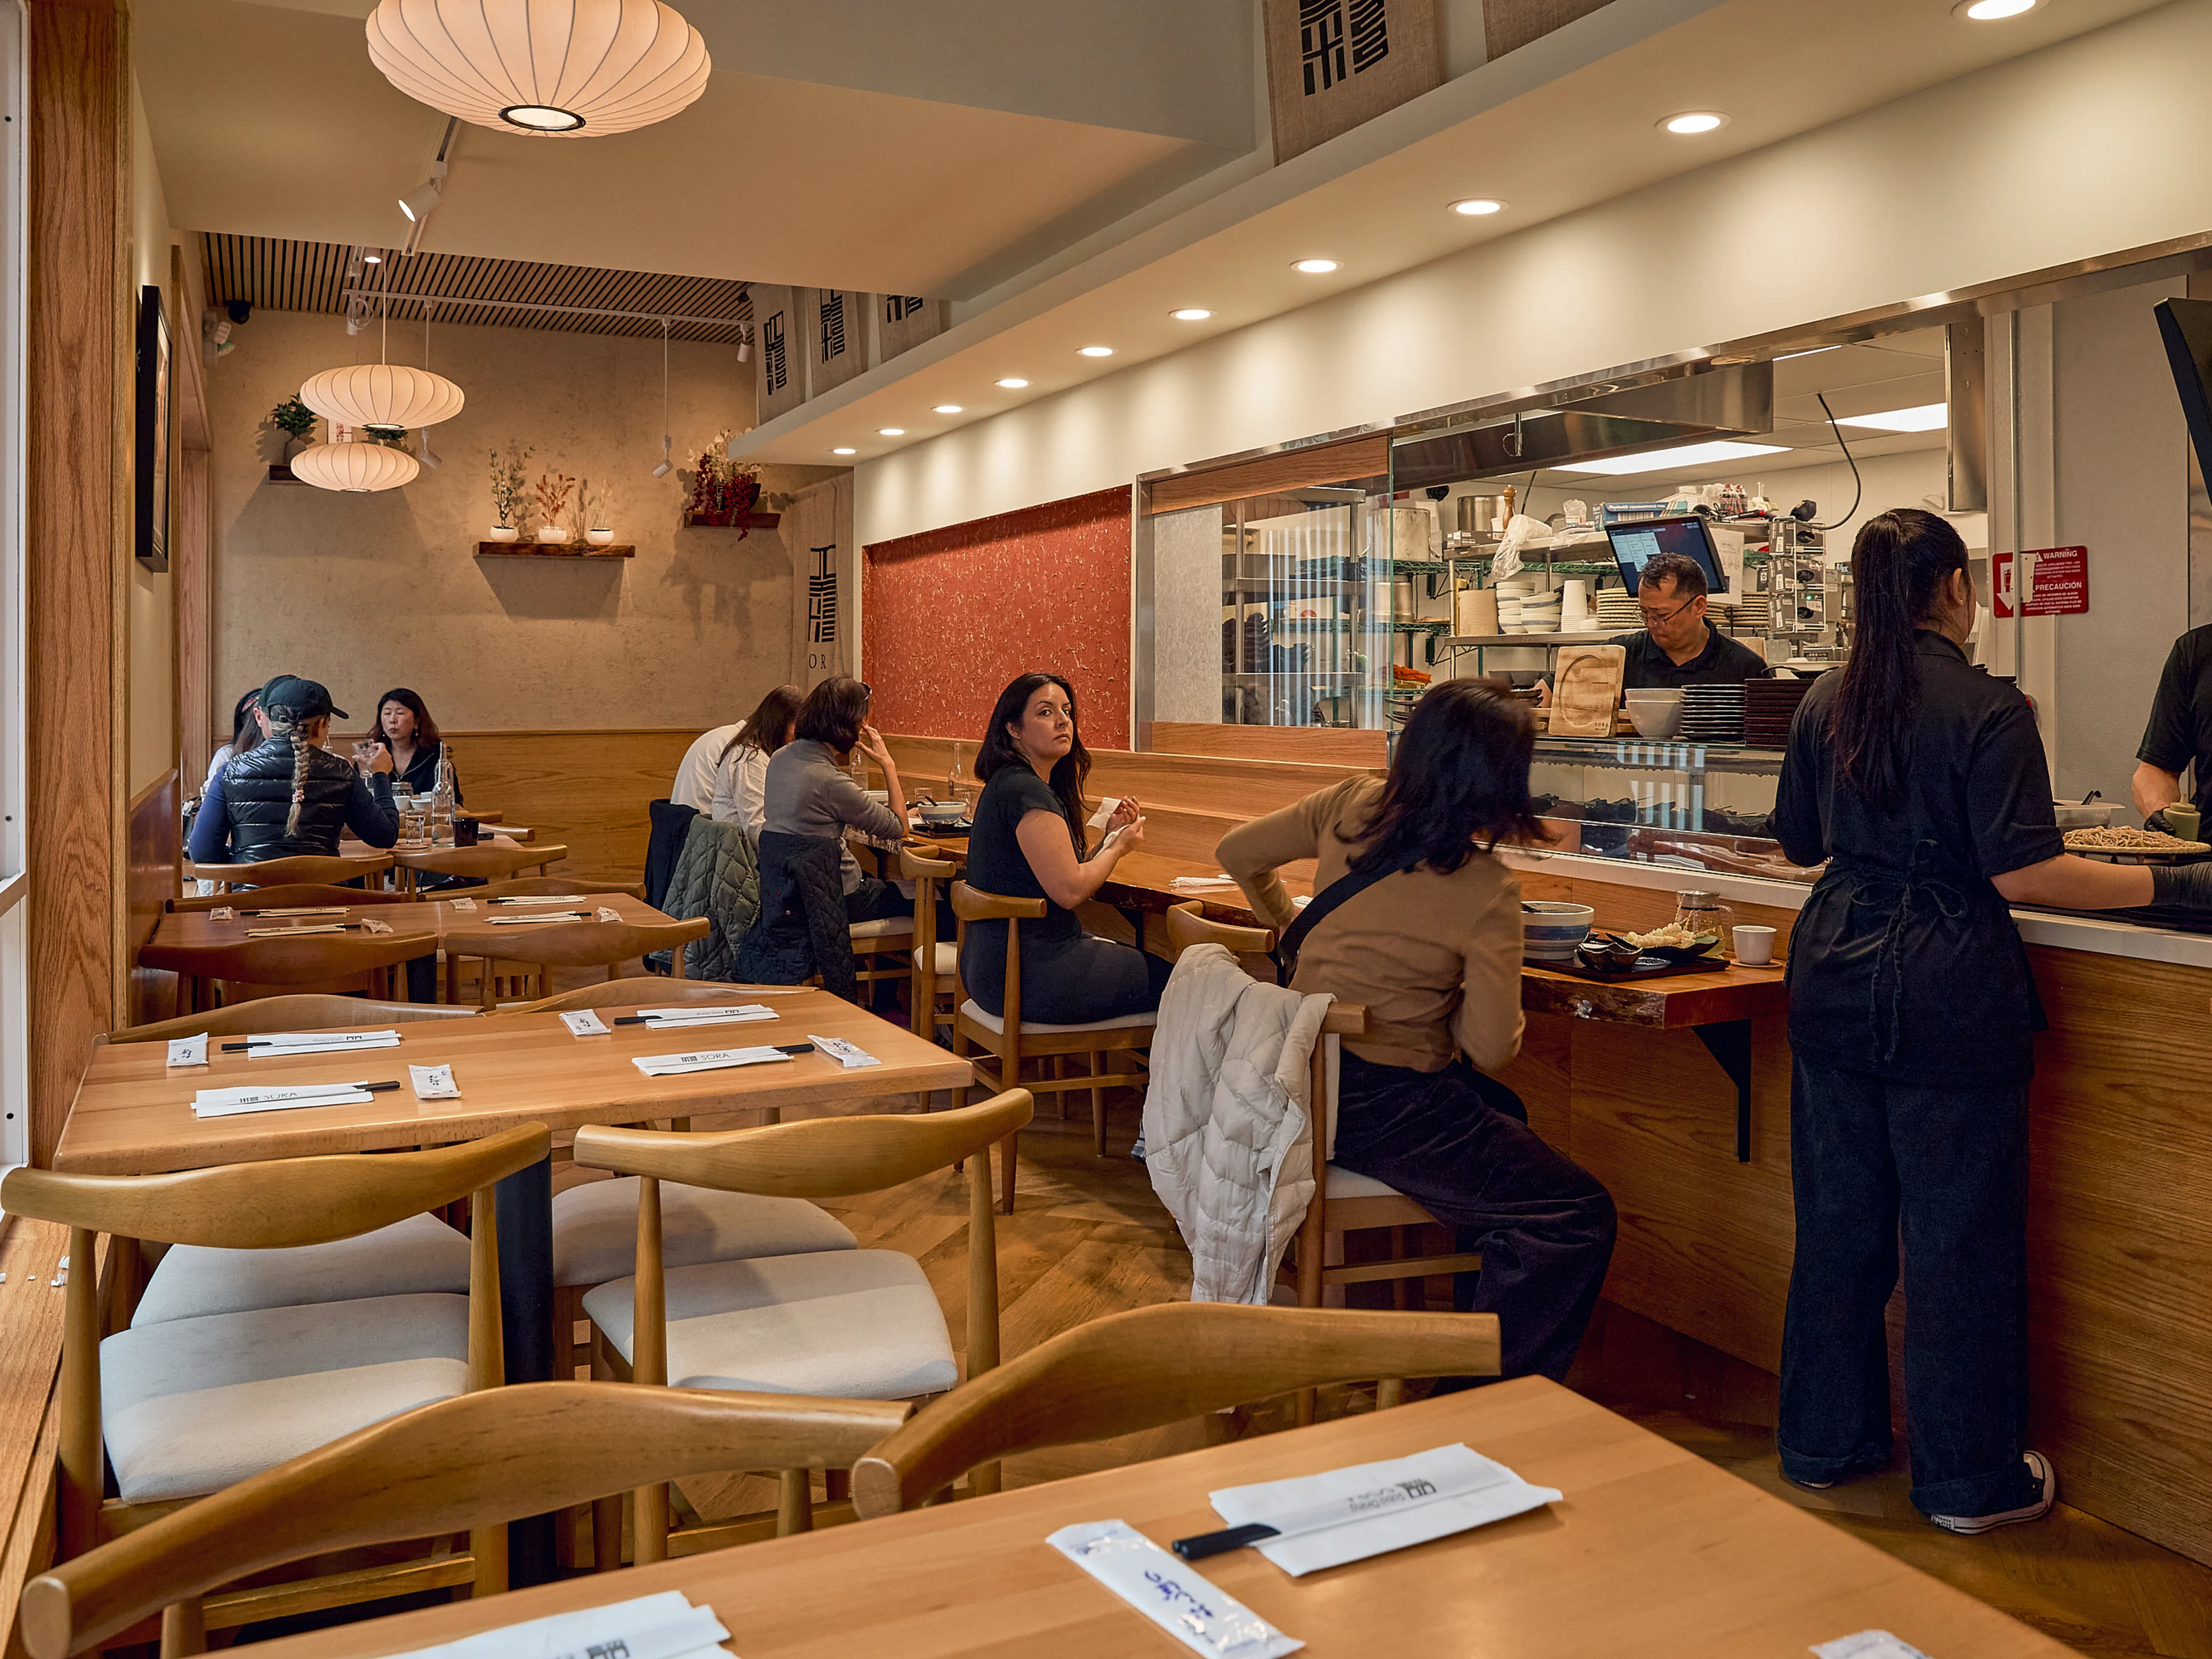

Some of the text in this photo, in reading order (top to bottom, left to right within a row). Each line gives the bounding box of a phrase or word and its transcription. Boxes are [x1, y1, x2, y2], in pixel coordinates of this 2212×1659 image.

[2043, 551, 2077, 559] WARNING
[2035, 581, 2082, 590] PRECAUCIÓN
[700, 1052, 730, 1060] SORA
